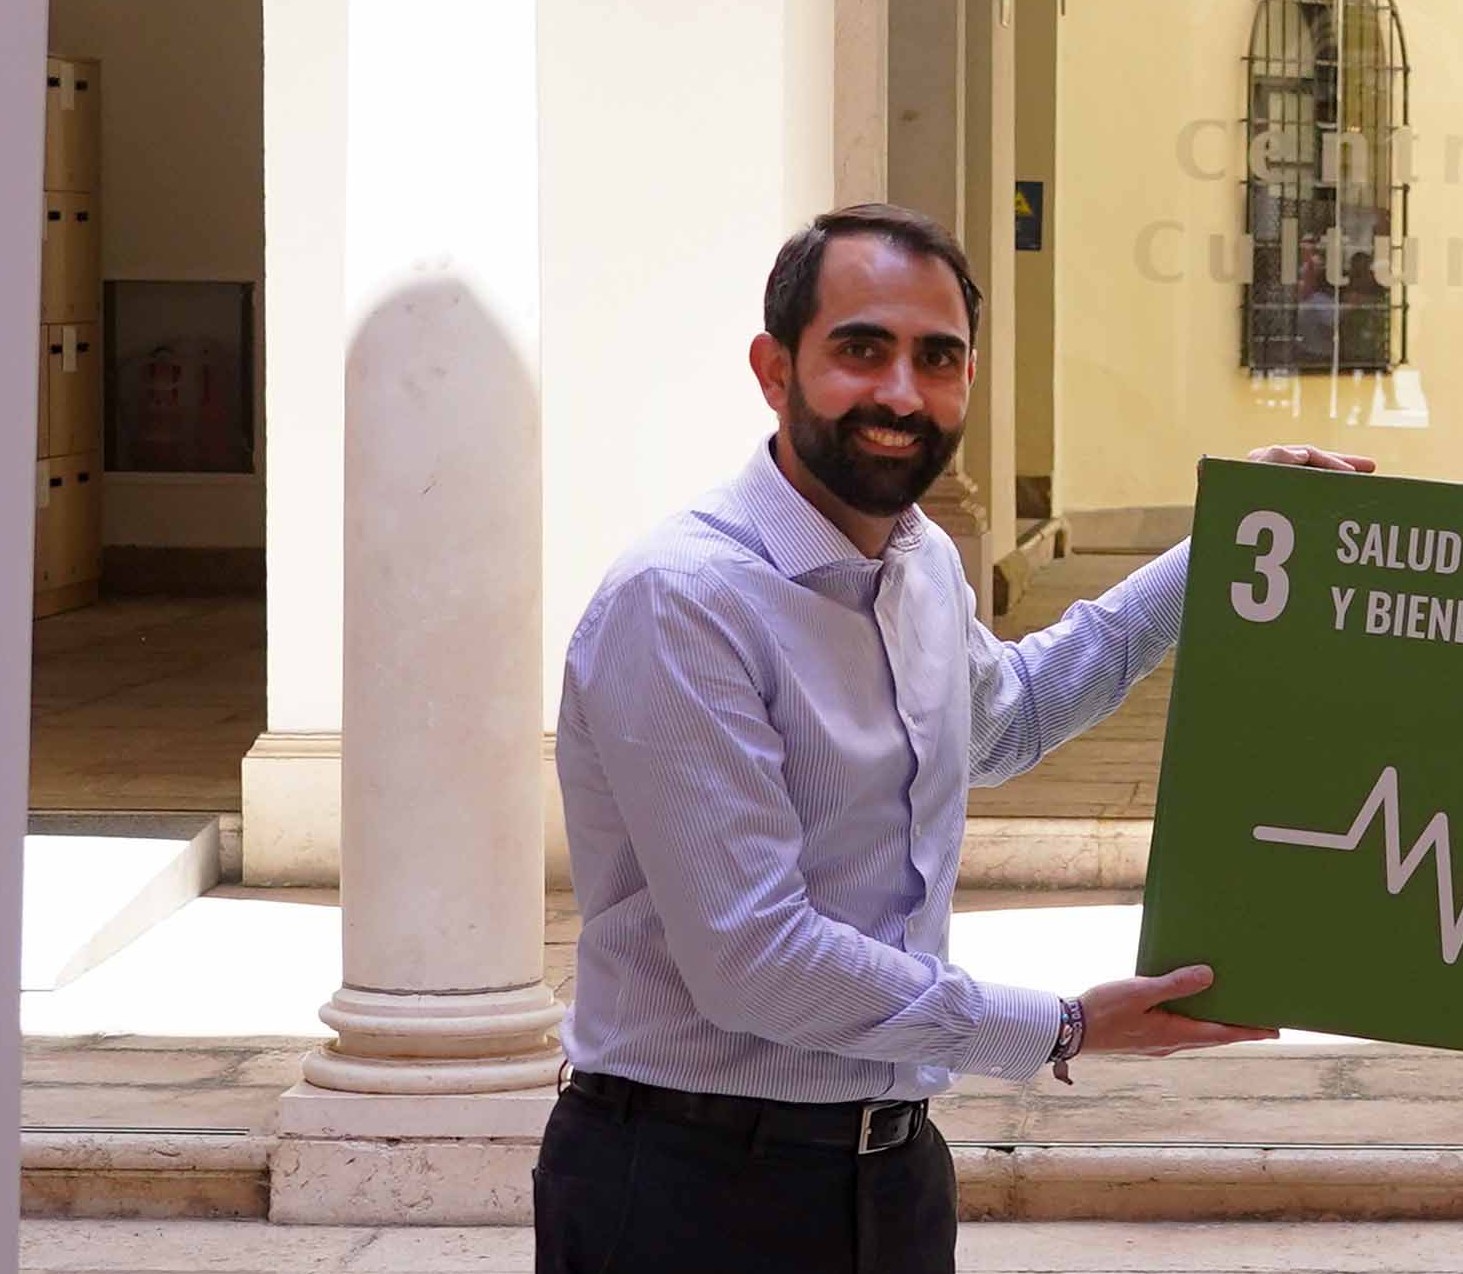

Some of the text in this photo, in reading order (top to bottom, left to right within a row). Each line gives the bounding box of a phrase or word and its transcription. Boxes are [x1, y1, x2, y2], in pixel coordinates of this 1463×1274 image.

[1231, 511, 1294, 622] 3
[1337, 521, 1461, 574] SALUD
[1332, 587, 1355, 630] Y
